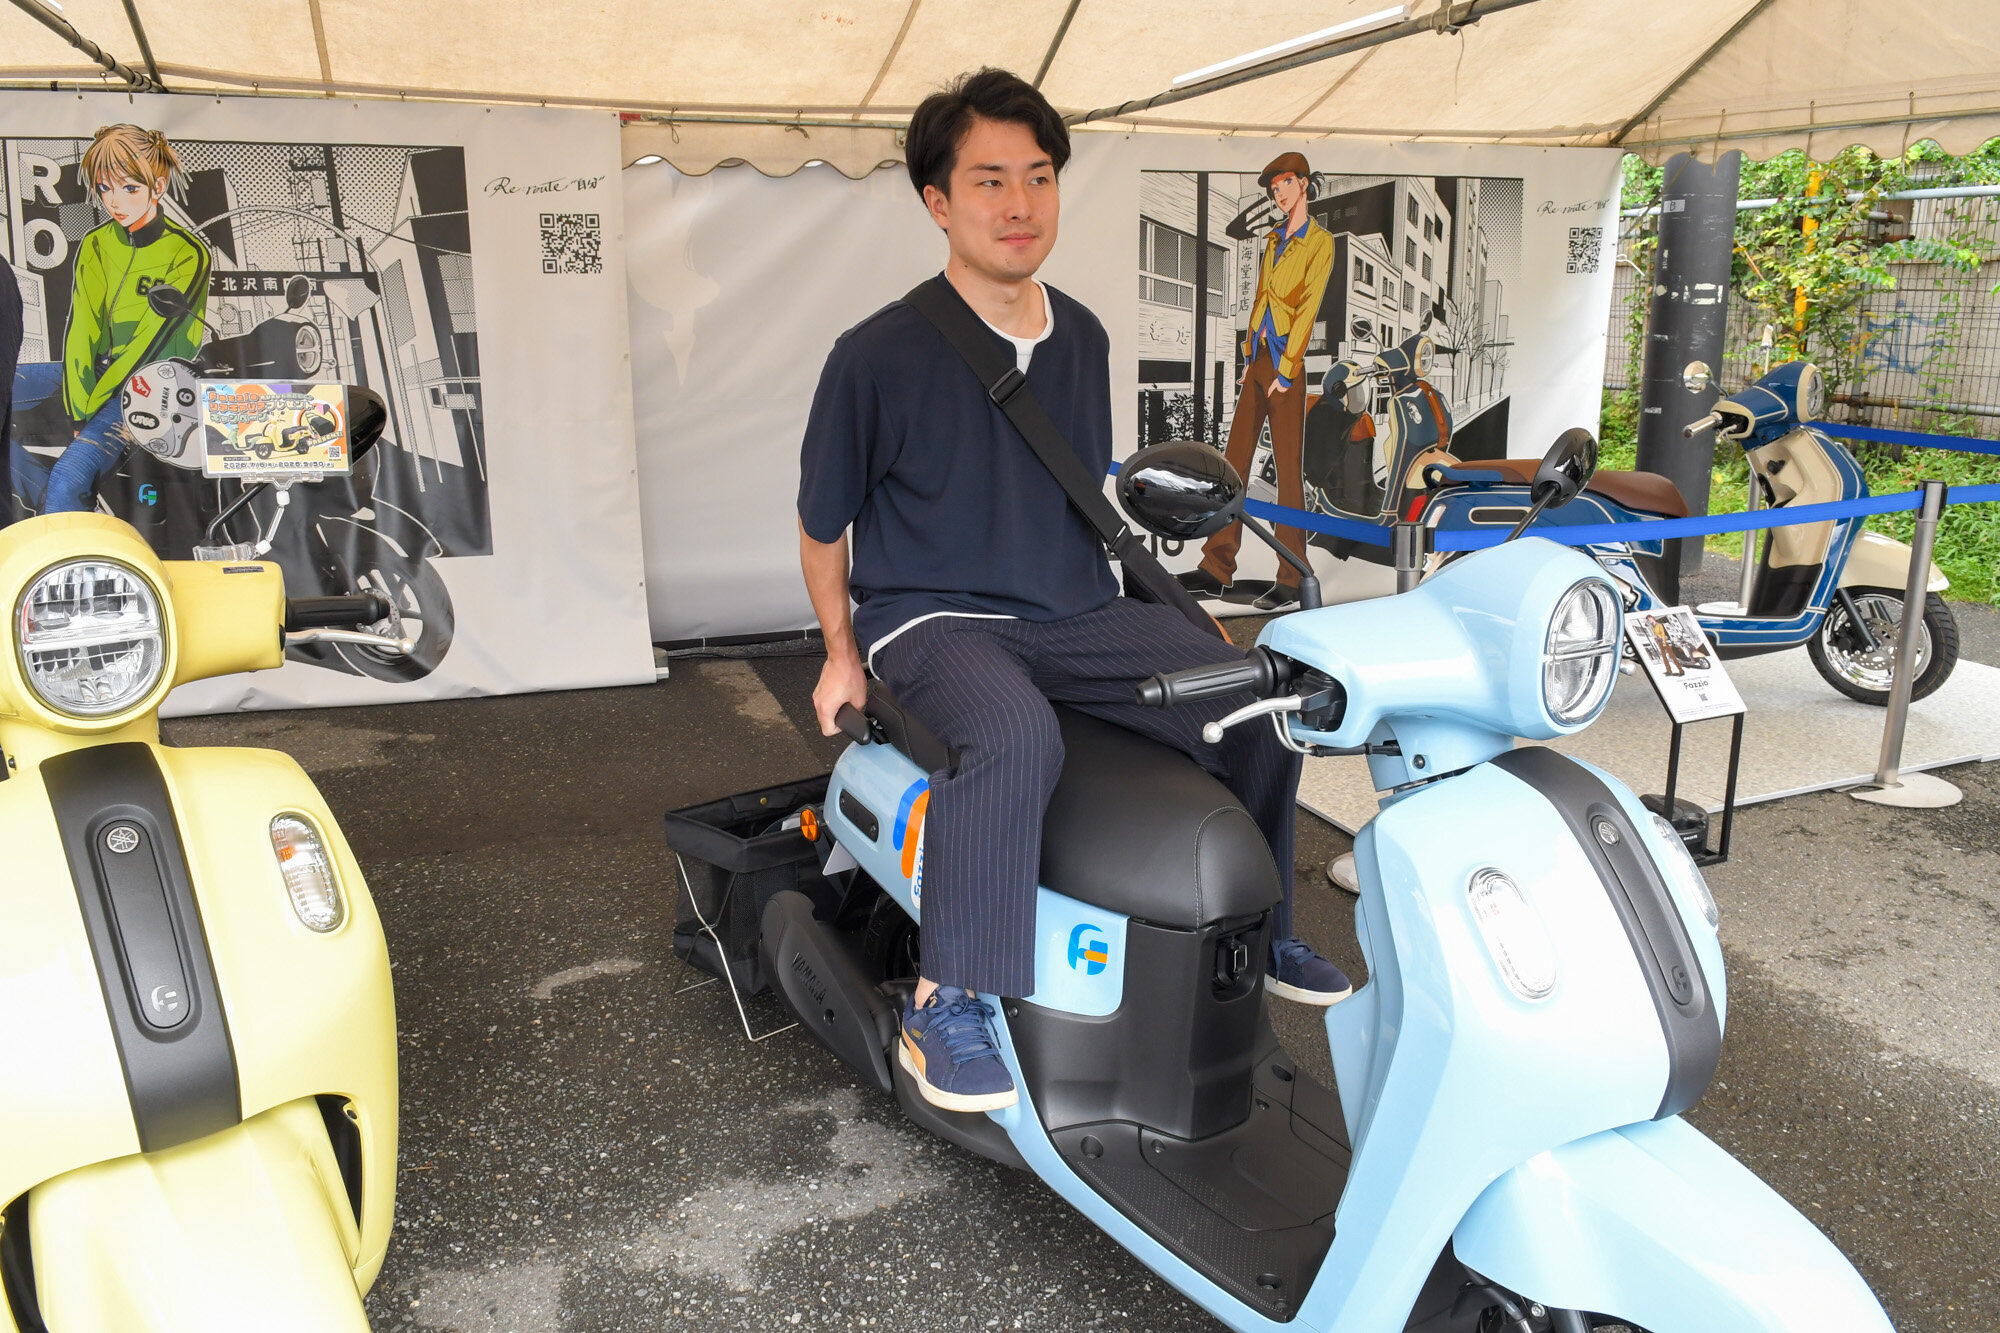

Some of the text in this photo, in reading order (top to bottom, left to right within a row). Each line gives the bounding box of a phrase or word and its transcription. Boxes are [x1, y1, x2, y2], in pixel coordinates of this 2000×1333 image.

[1240, 237, 1253, 312] 海堂書店
[1683, 680, 1709, 690] Fazzio
